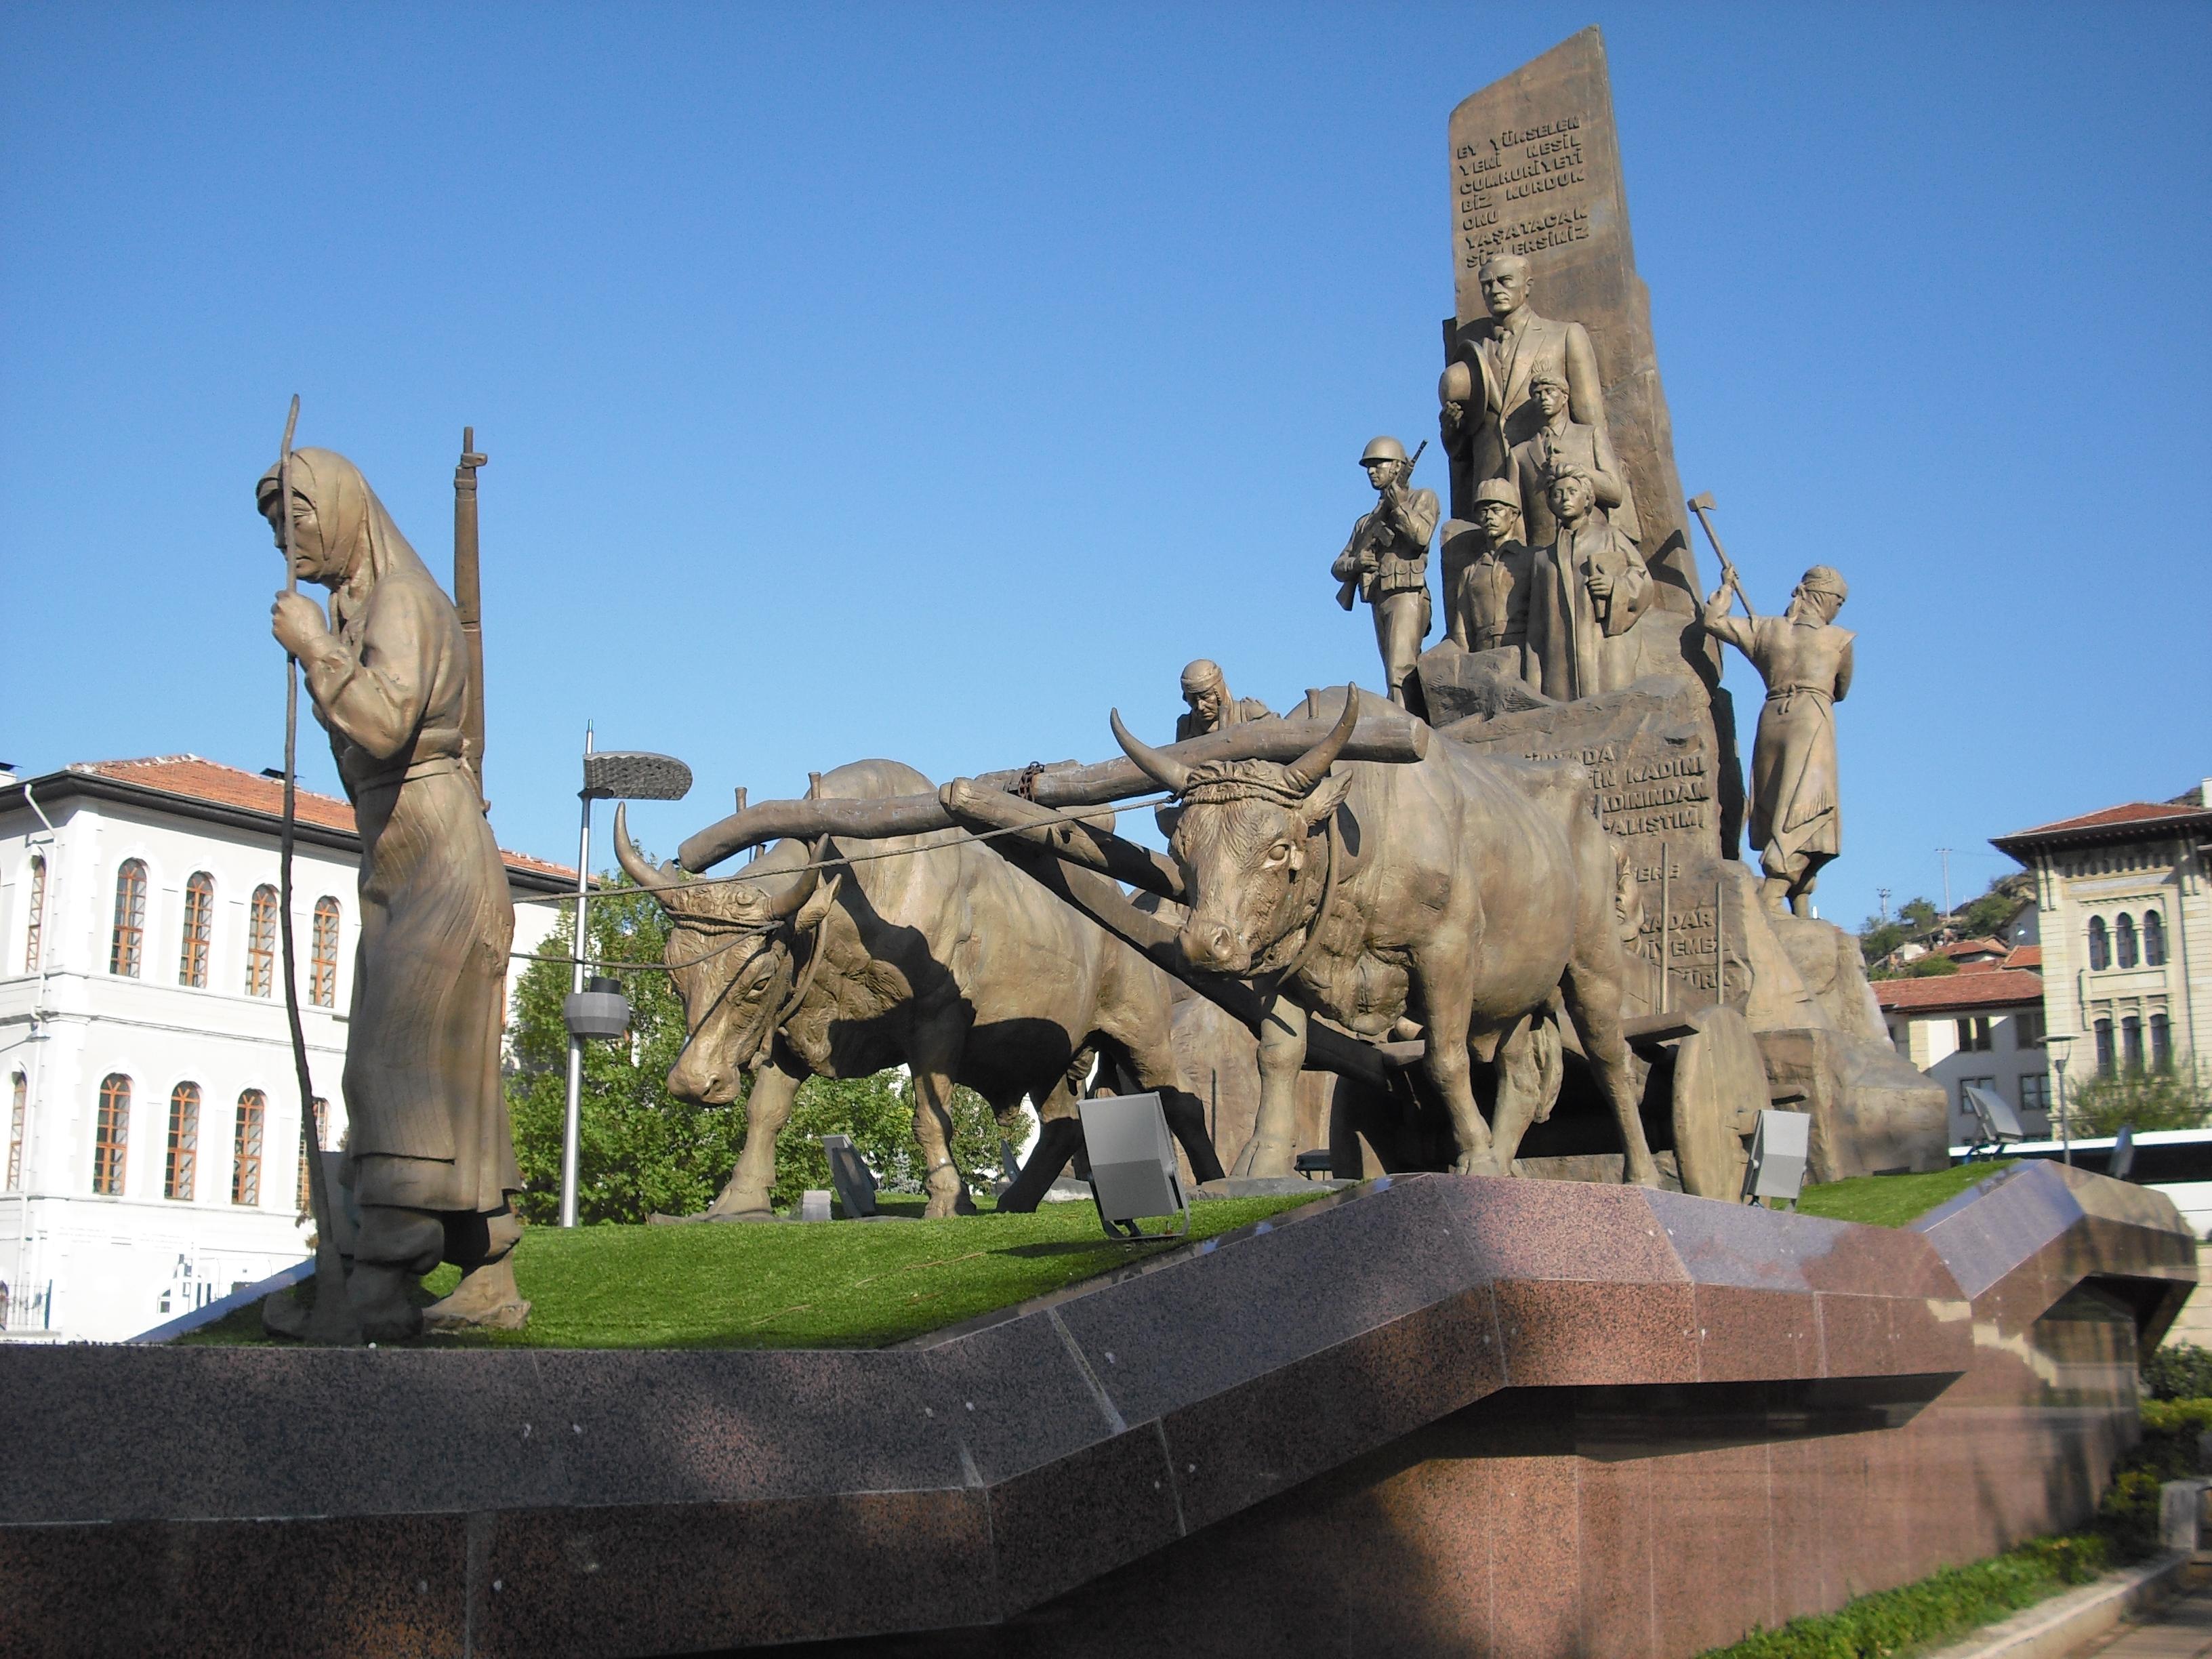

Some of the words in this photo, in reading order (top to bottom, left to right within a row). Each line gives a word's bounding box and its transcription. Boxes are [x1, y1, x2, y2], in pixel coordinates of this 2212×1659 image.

[1458, 142, 1479, 159] EY
[1490, 116, 1580, 151] YÜKSELEN
[1459, 152, 1502, 176] YENİ
[1526, 134, 1581, 159] NESİL
[1460, 148, 1583, 194] CUMHURİYETİ
[1462, 194, 1492, 213] BİZ
[1506, 169, 1584, 201] KURDUK
[1463, 209, 1499, 230] ONU
[1465, 205, 1587, 249] YAŞATACAK
